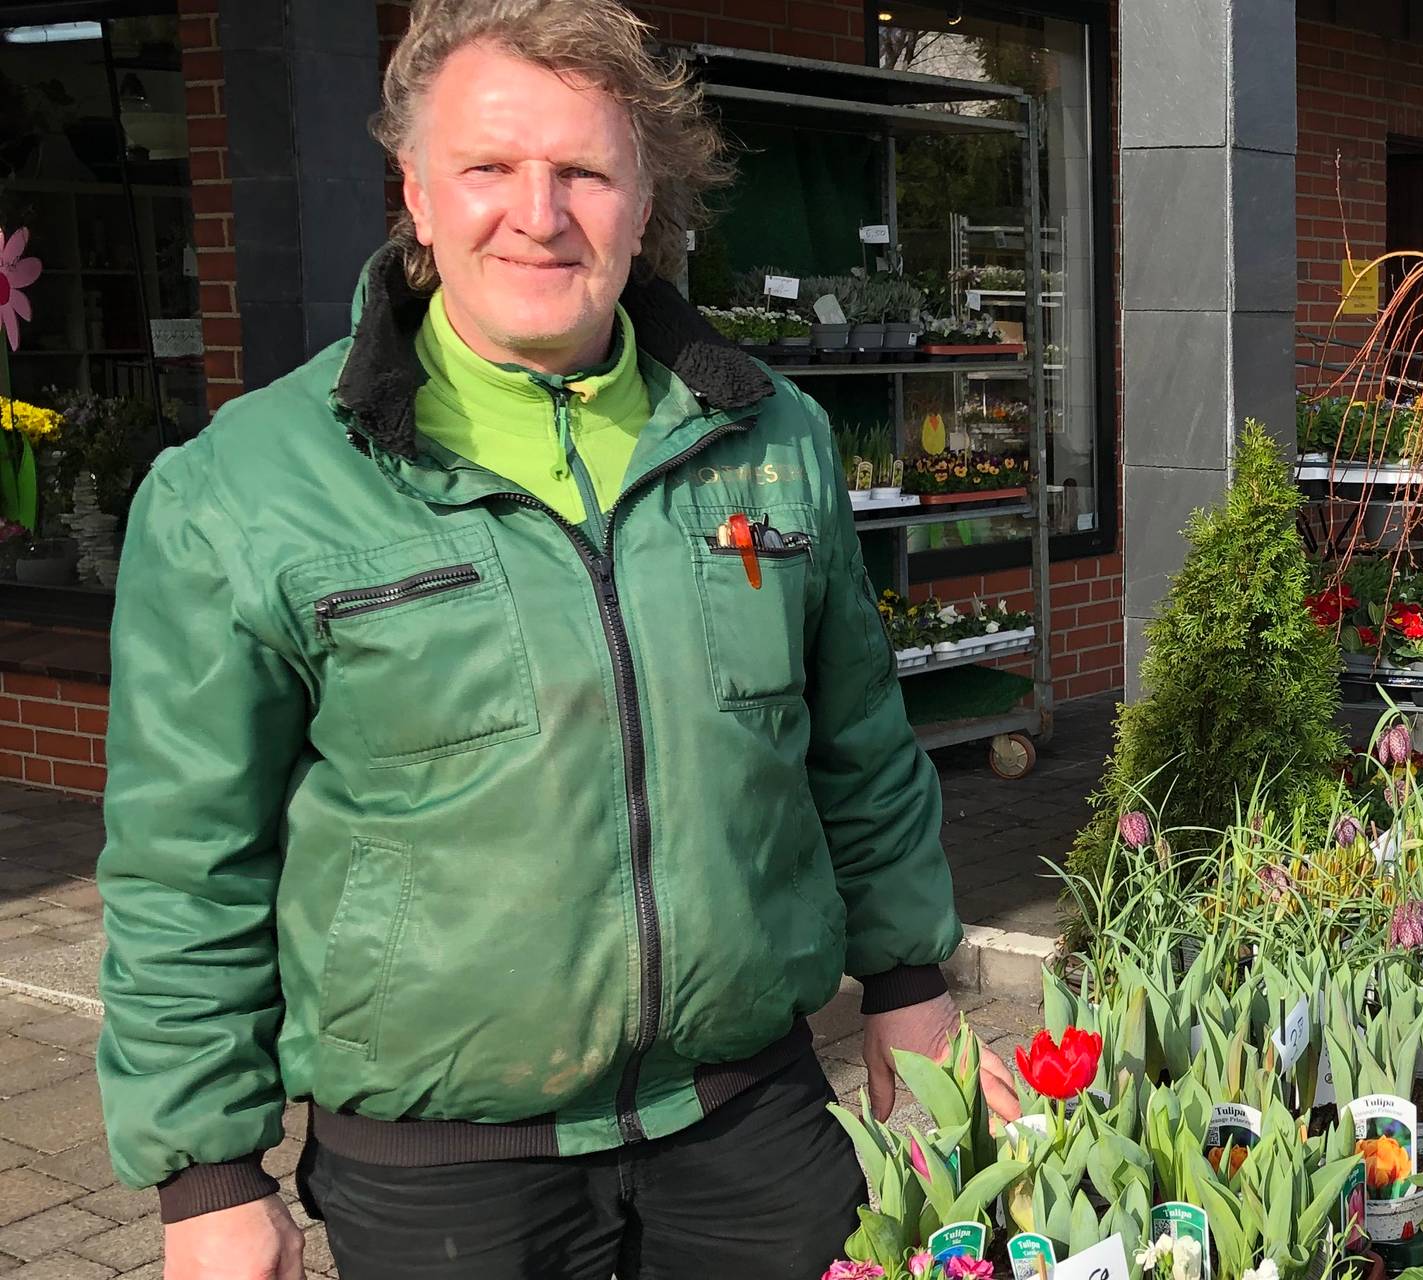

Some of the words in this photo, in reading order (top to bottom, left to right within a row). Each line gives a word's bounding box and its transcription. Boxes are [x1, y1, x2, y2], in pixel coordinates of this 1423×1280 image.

[1365, 1099, 1394, 1107] Tulipa
[1215, 1106, 1246, 1117] Tulipa
[1162, 1208, 1192, 1219] Tulipa
[943, 1228, 971, 1241] Tulipa
[1017, 1239, 1040, 1249] Tulipa
